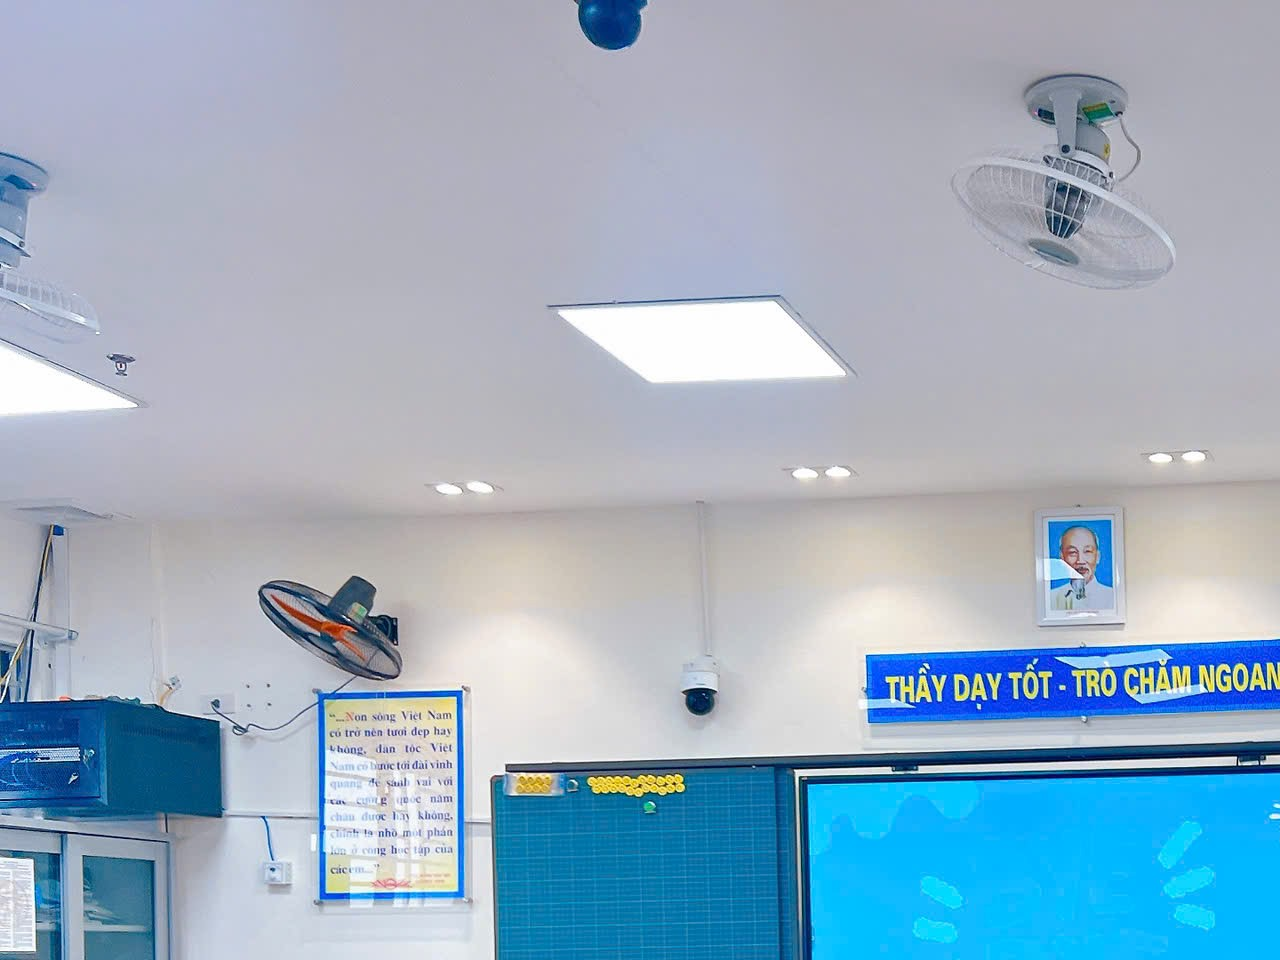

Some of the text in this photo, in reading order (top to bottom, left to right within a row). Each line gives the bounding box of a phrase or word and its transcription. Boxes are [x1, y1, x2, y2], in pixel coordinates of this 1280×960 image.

[886, 663, 947, 703] THẦY
[954, 673, 1002, 710] DẠY
[1009, 658, 1052, 699] TỐT
[1072, 661, 1117, 698] TRÒ
[428, 710, 452, 720] Nam
[434, 726, 452, 737] hay
[417, 777, 431, 786] vai
